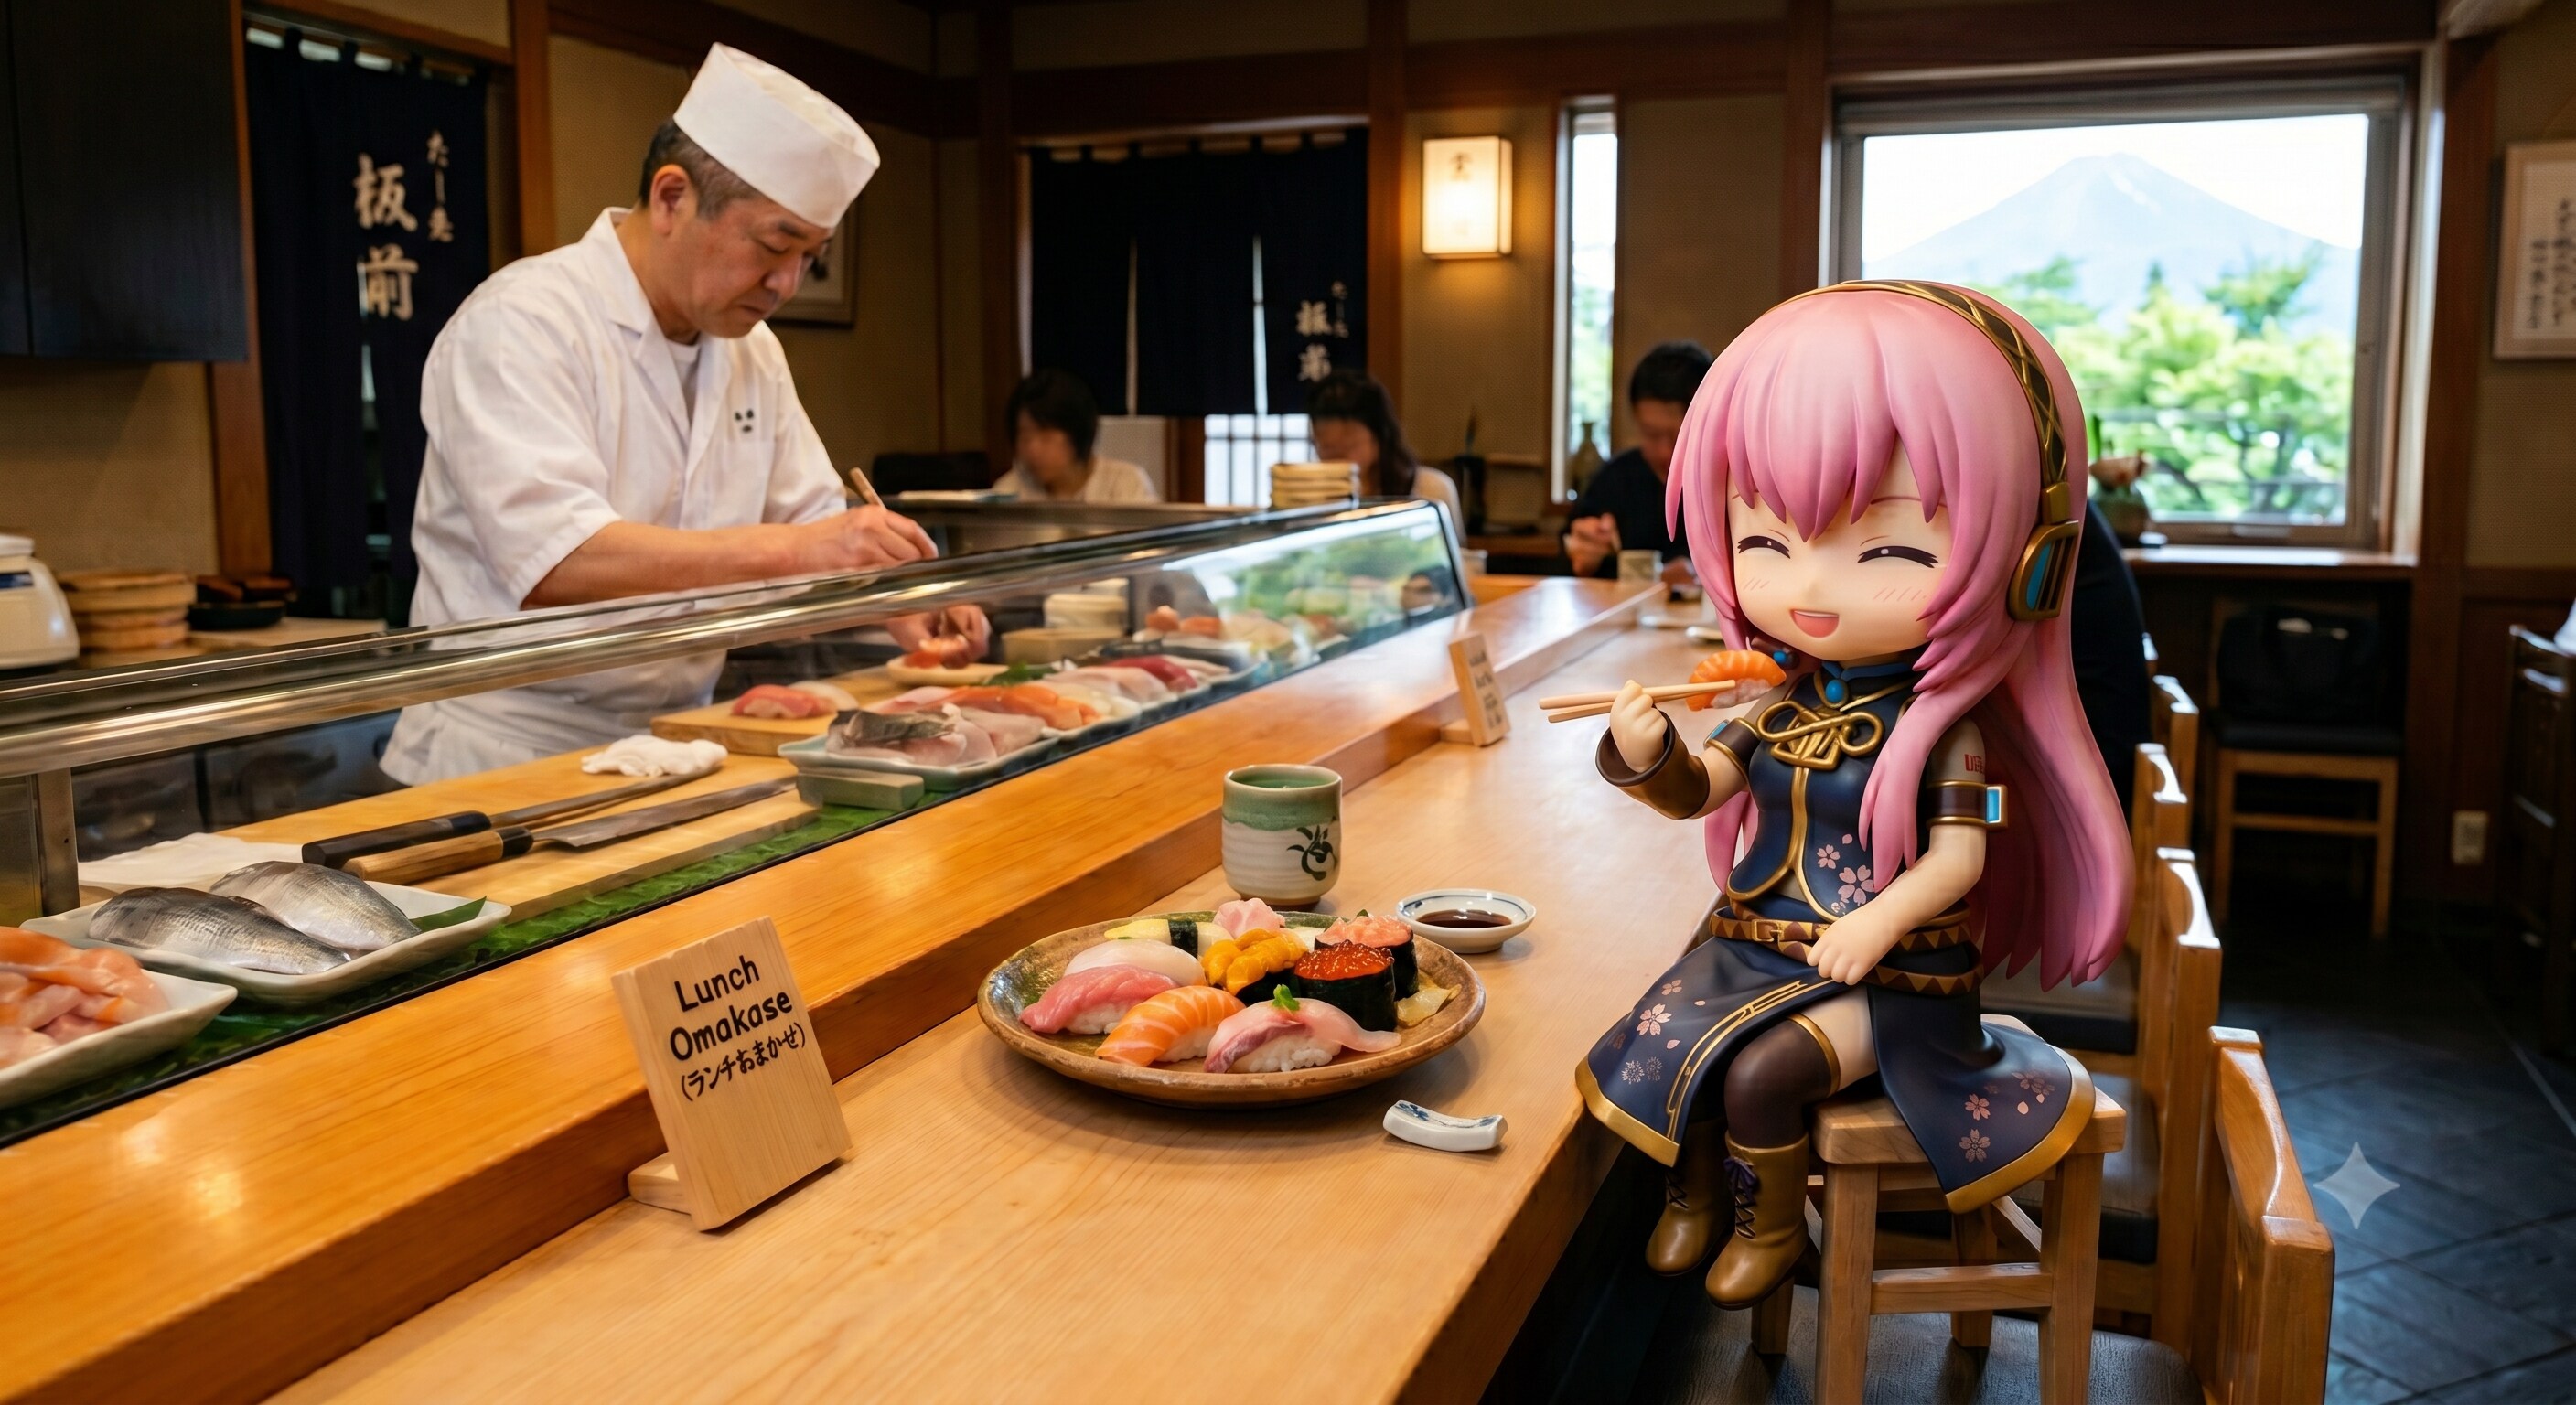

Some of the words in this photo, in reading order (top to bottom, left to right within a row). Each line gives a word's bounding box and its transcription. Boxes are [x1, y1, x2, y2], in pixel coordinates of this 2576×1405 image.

[353, 153, 419, 320] 板前
[674, 955, 760, 1013] Lunch
[670, 992, 793, 1061] Omakase
[682, 1022, 806, 1101] (ランチおまかせ)
